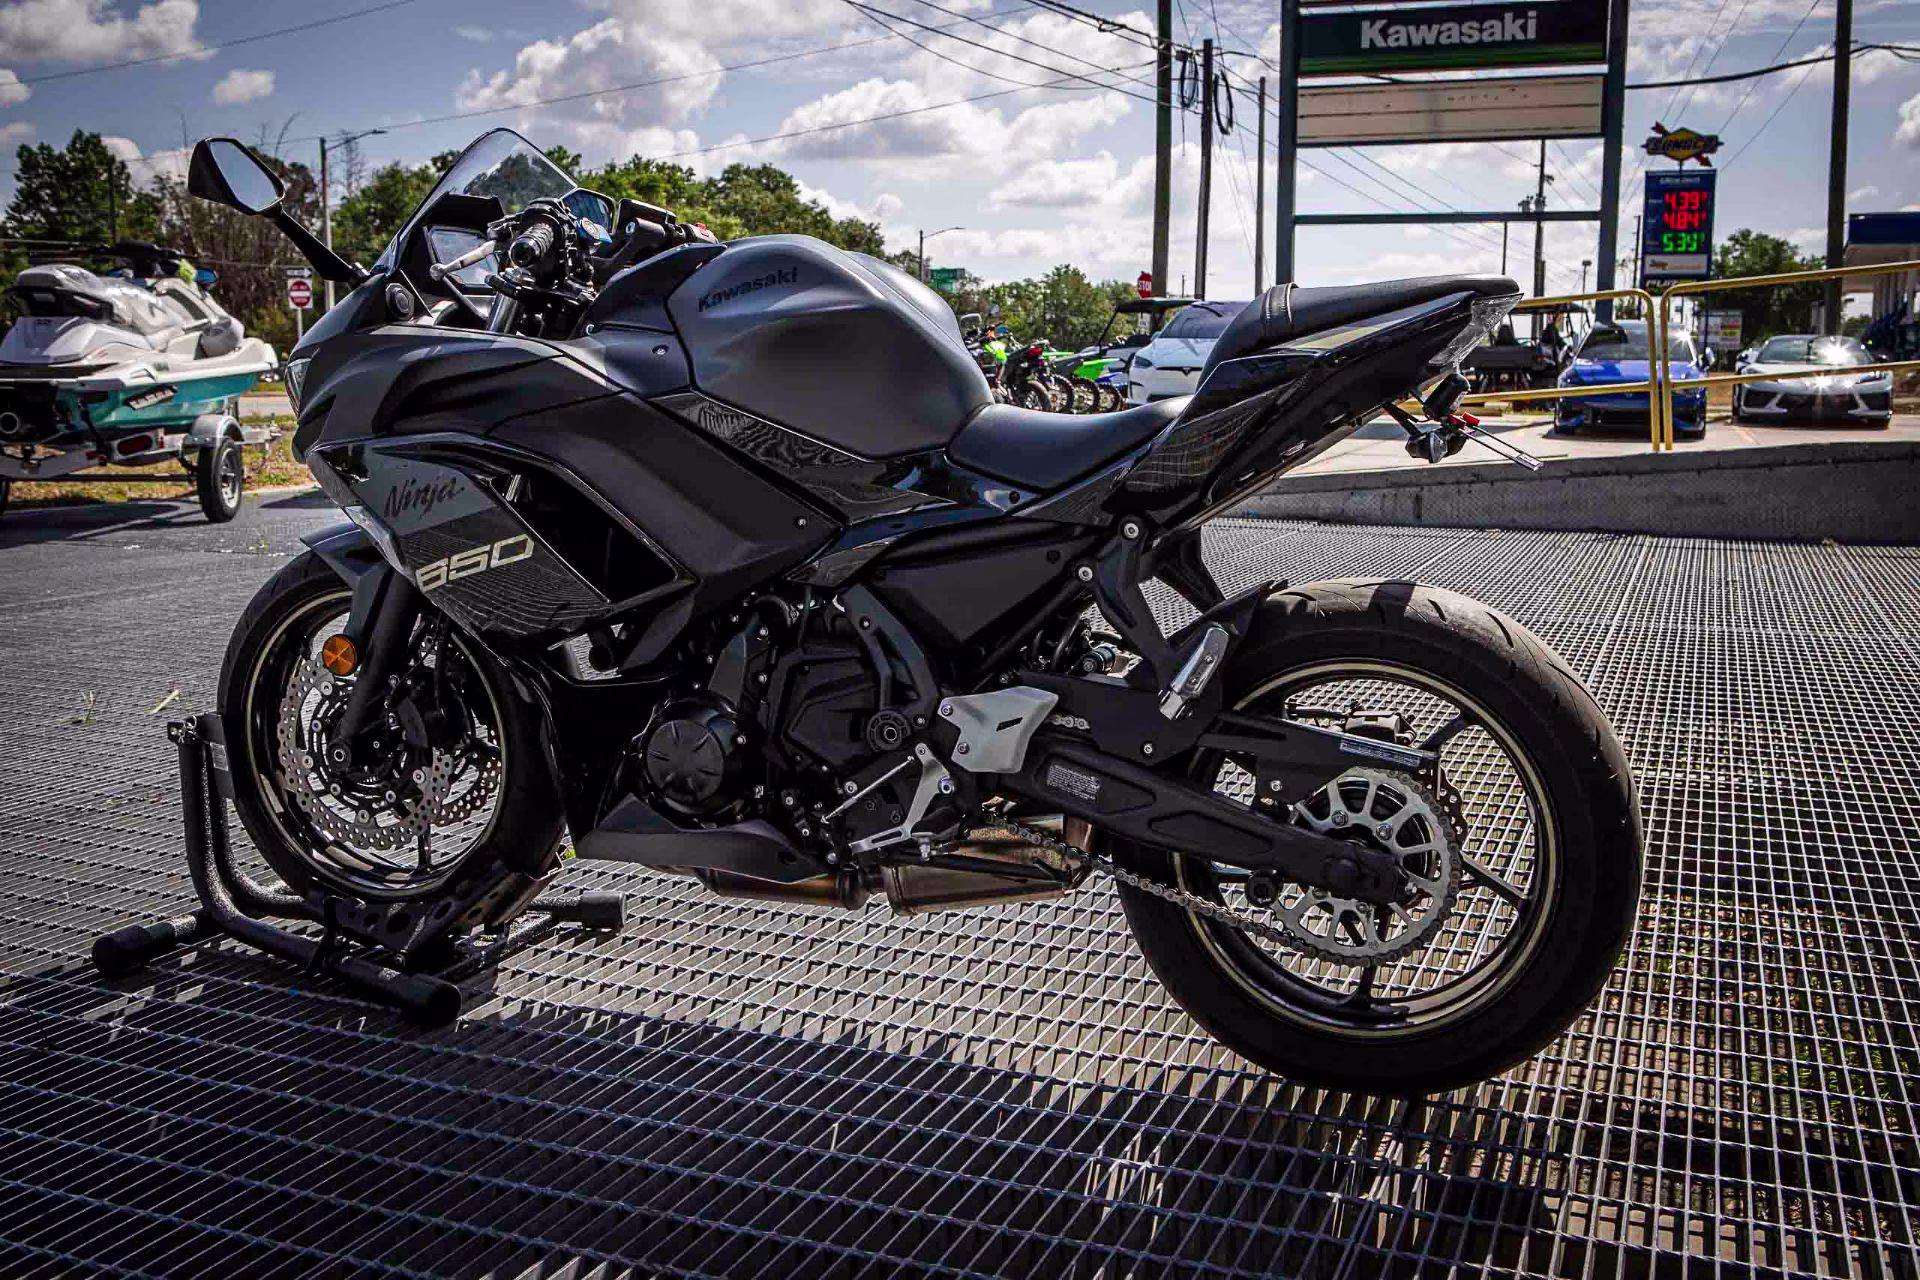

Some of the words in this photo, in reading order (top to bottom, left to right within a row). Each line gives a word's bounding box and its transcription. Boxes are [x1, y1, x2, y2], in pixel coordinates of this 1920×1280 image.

[1360, 10, 1537, 49] Kawasaki
[698, 266, 798, 312] Kawasaki
[384, 478, 465, 520] Ninja
[415, 534, 535, 593] 650
